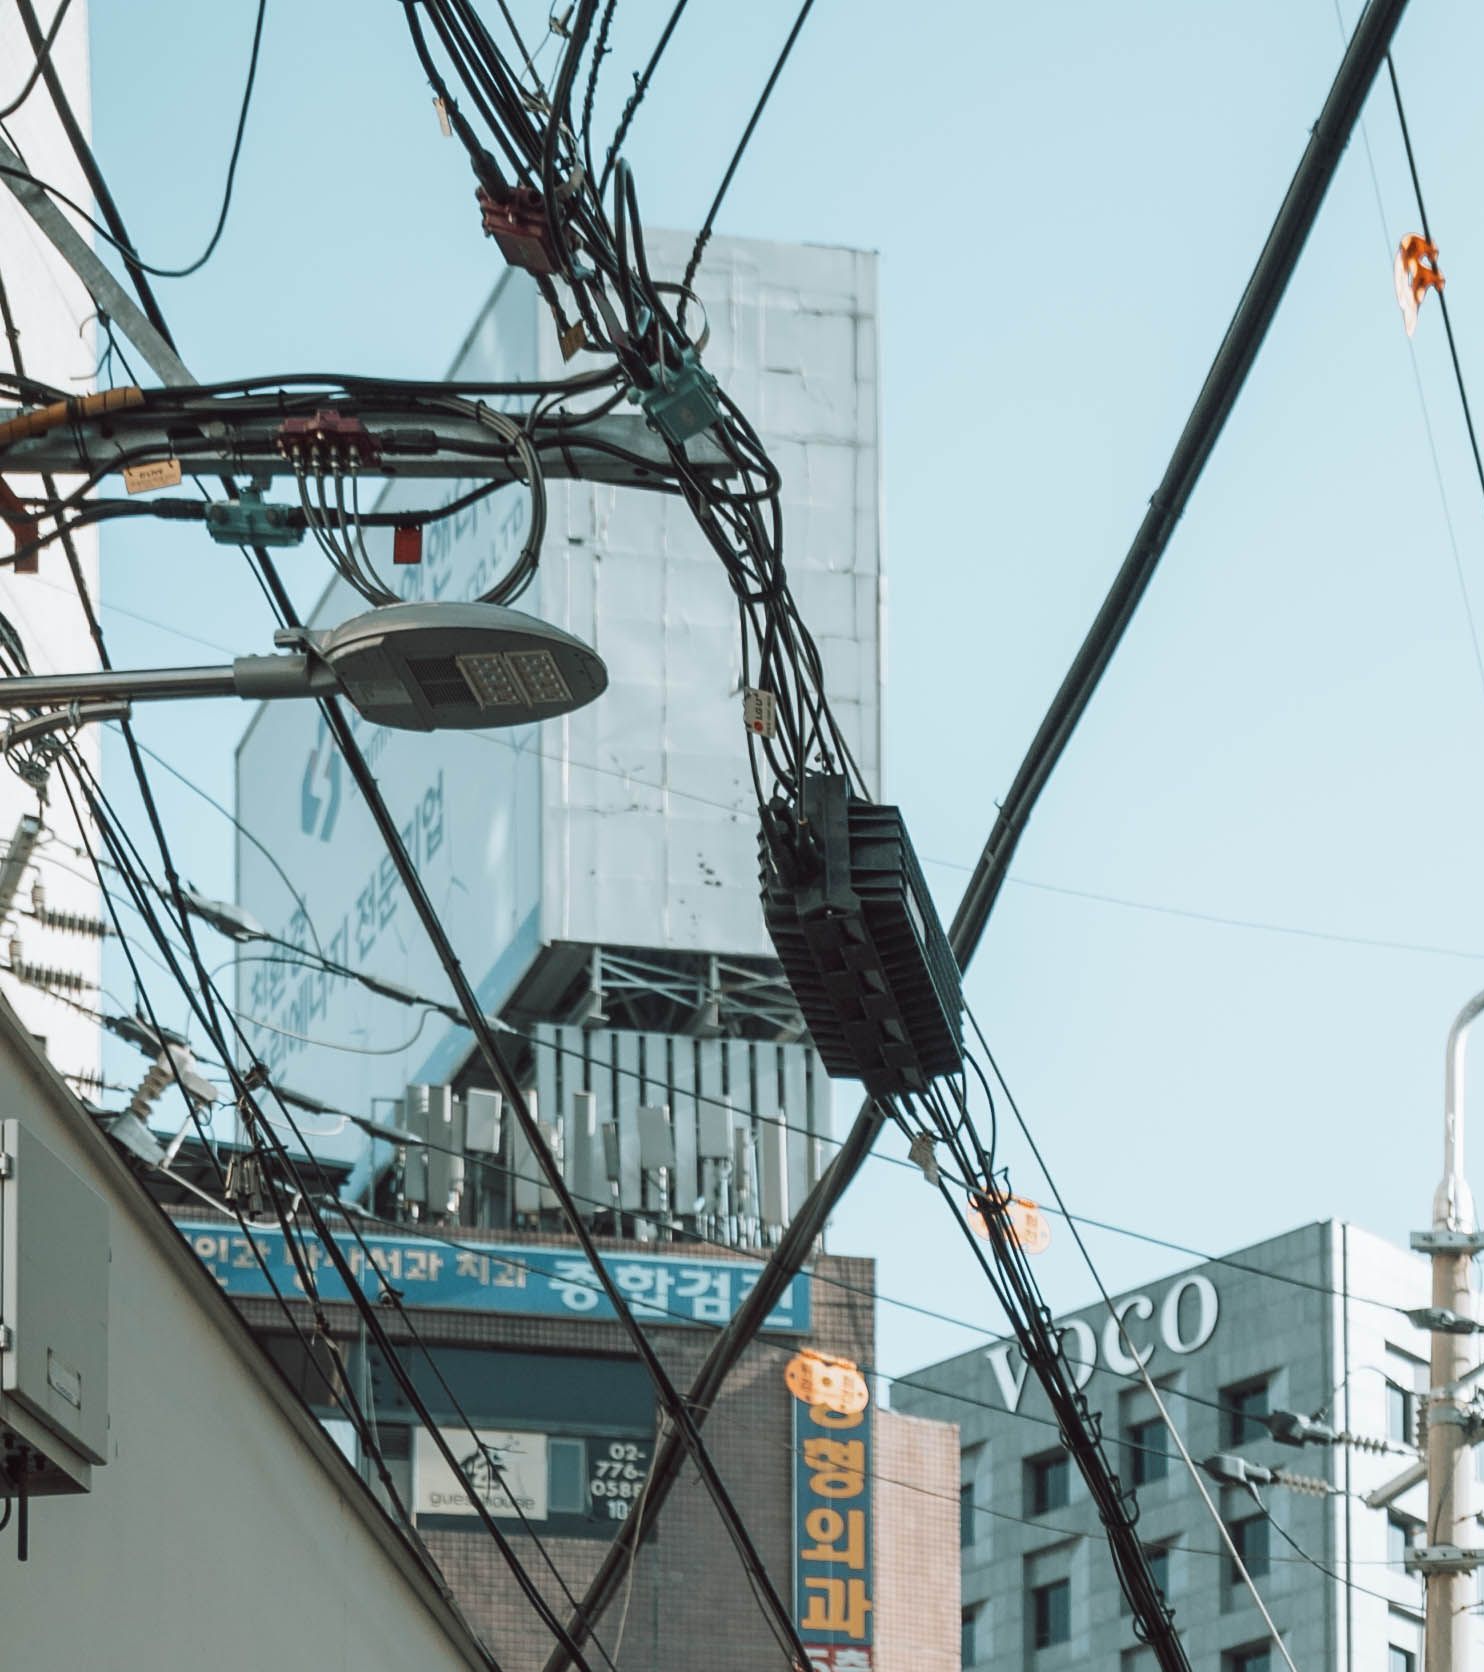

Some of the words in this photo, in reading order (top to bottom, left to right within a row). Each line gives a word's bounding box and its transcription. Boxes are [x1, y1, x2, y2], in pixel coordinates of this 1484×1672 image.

[181, 1235, 271, 1288] 인과
[456, 1251, 528, 1290] 치과
[608, 1443, 646, 1461] 02-
[595, 1461, 646, 1479] 776-
[429, 1489, 536, 1509] gueshouse
